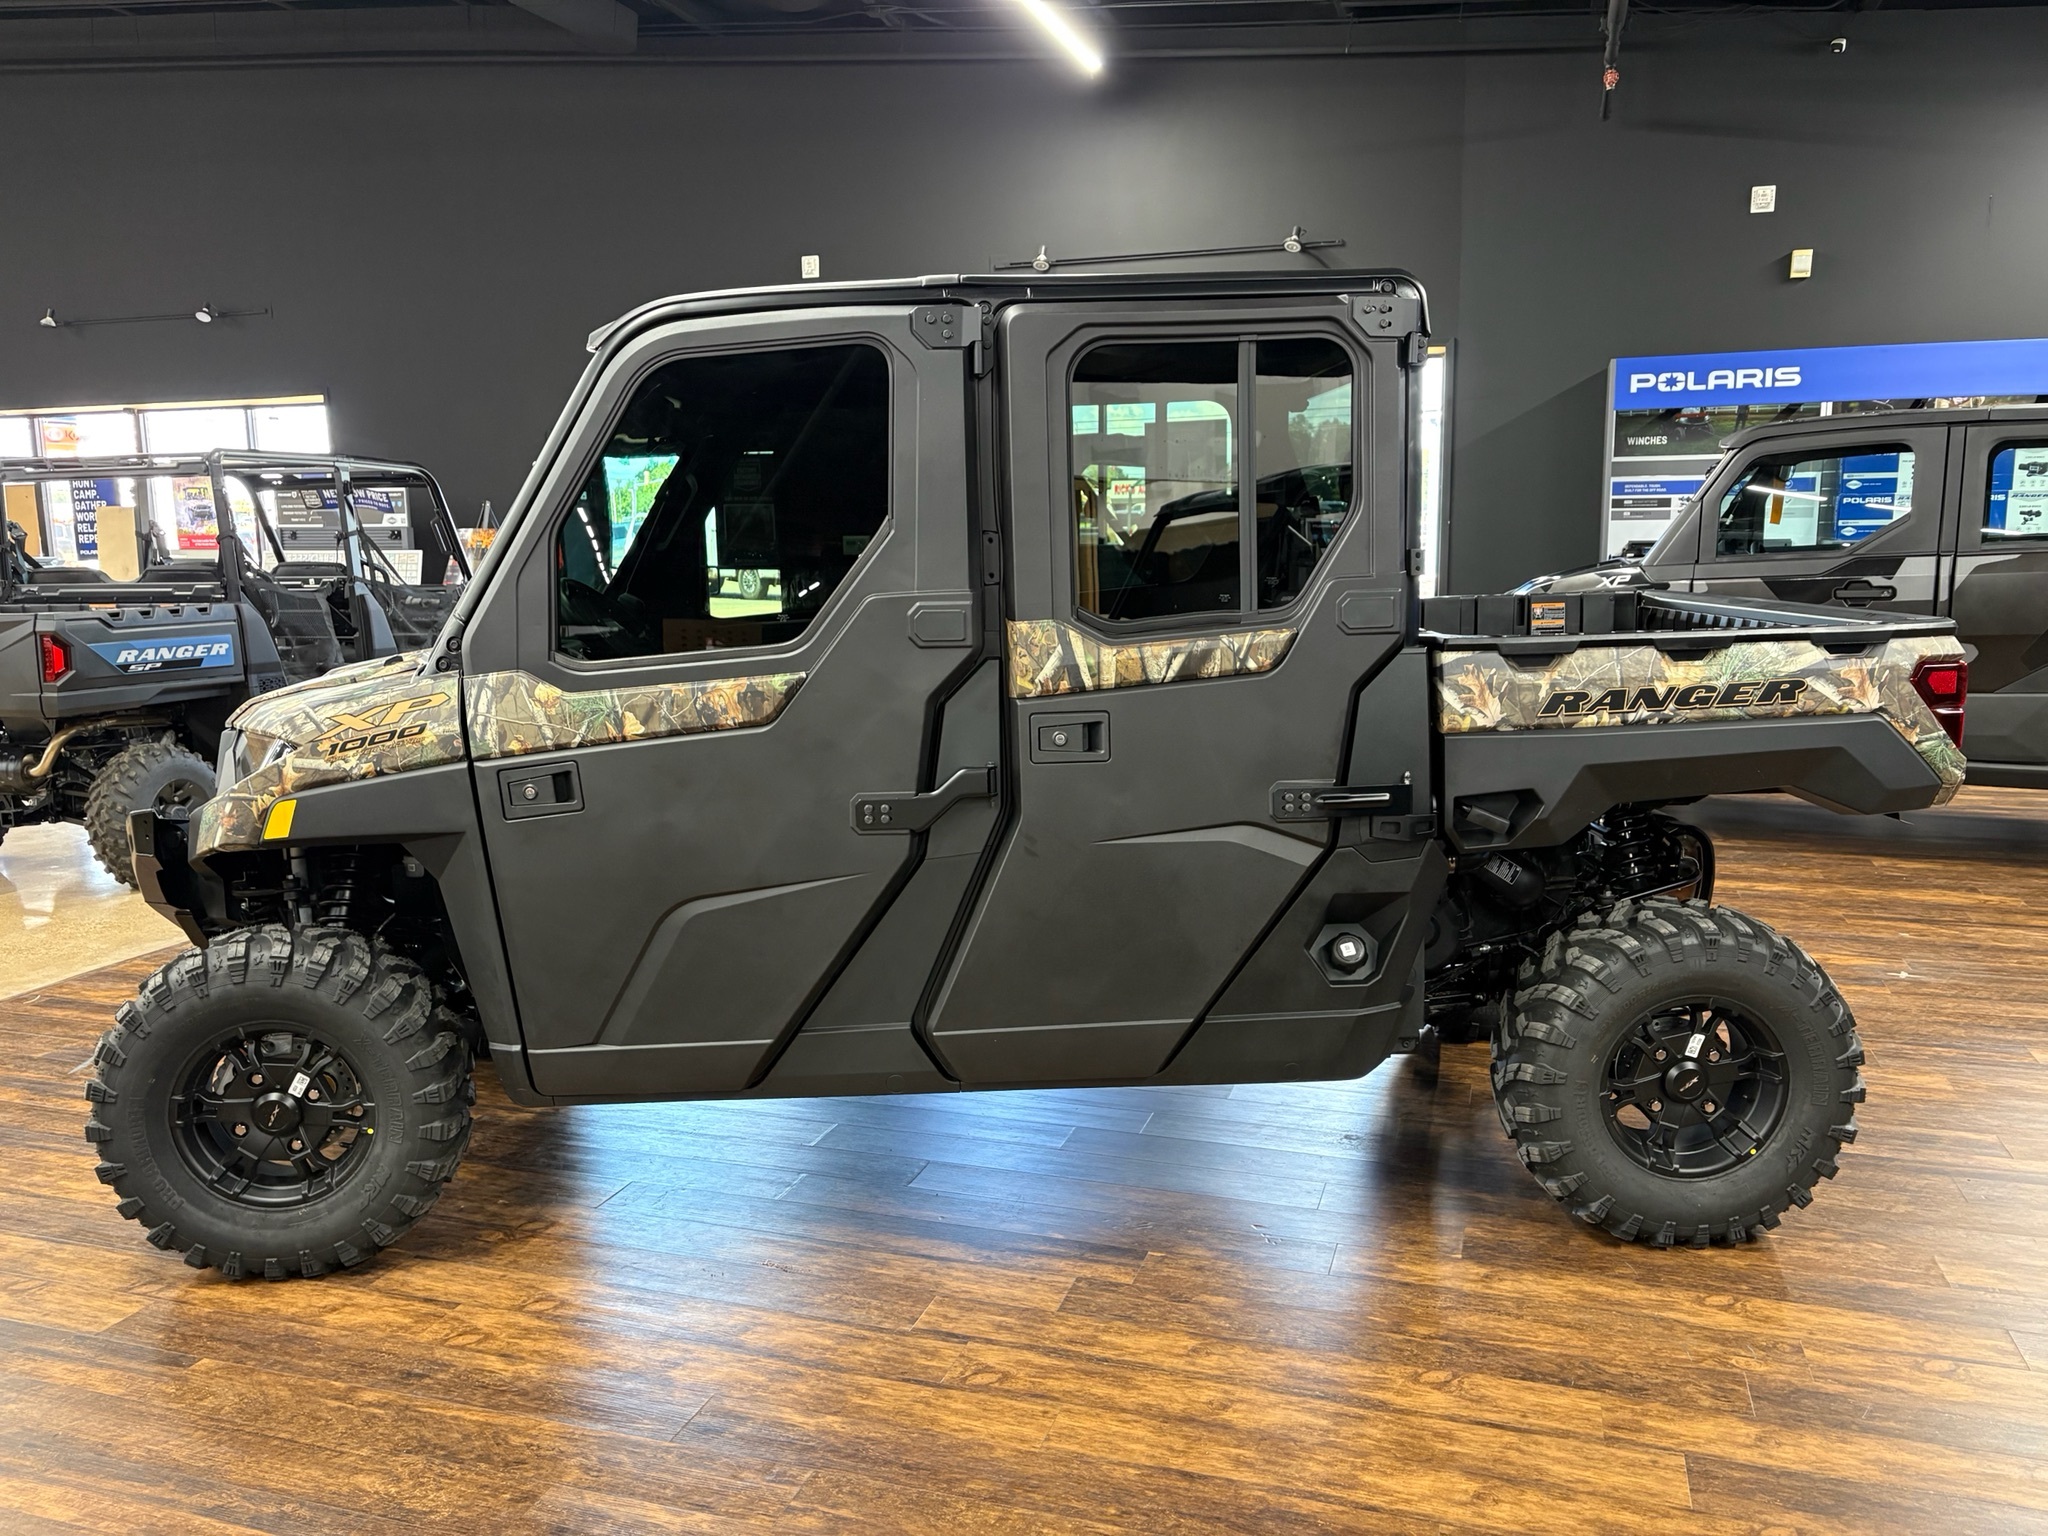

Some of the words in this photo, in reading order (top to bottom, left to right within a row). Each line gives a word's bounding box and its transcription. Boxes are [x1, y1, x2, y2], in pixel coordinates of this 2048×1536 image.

[1630, 366, 1802, 394] POLARIS
[1627, 435, 1668, 446] WINCHES
[73, 489, 100, 500] CAMP.
[322, 489, 338, 499] NE
[365, 490, 389, 503] PRICE
[1842, 496, 1893, 504] POLARIS
[77, 522, 98, 533] RELA
[78, 533, 98, 544] REPE
[1595, 574, 1632, 589] XP
[116, 642, 229, 663] RANGER
[127, 662, 163, 673] SP
[1537, 678, 1808, 717] RANGER
[311, 691, 451, 742] XP
[327, 722, 429, 756] 1000
